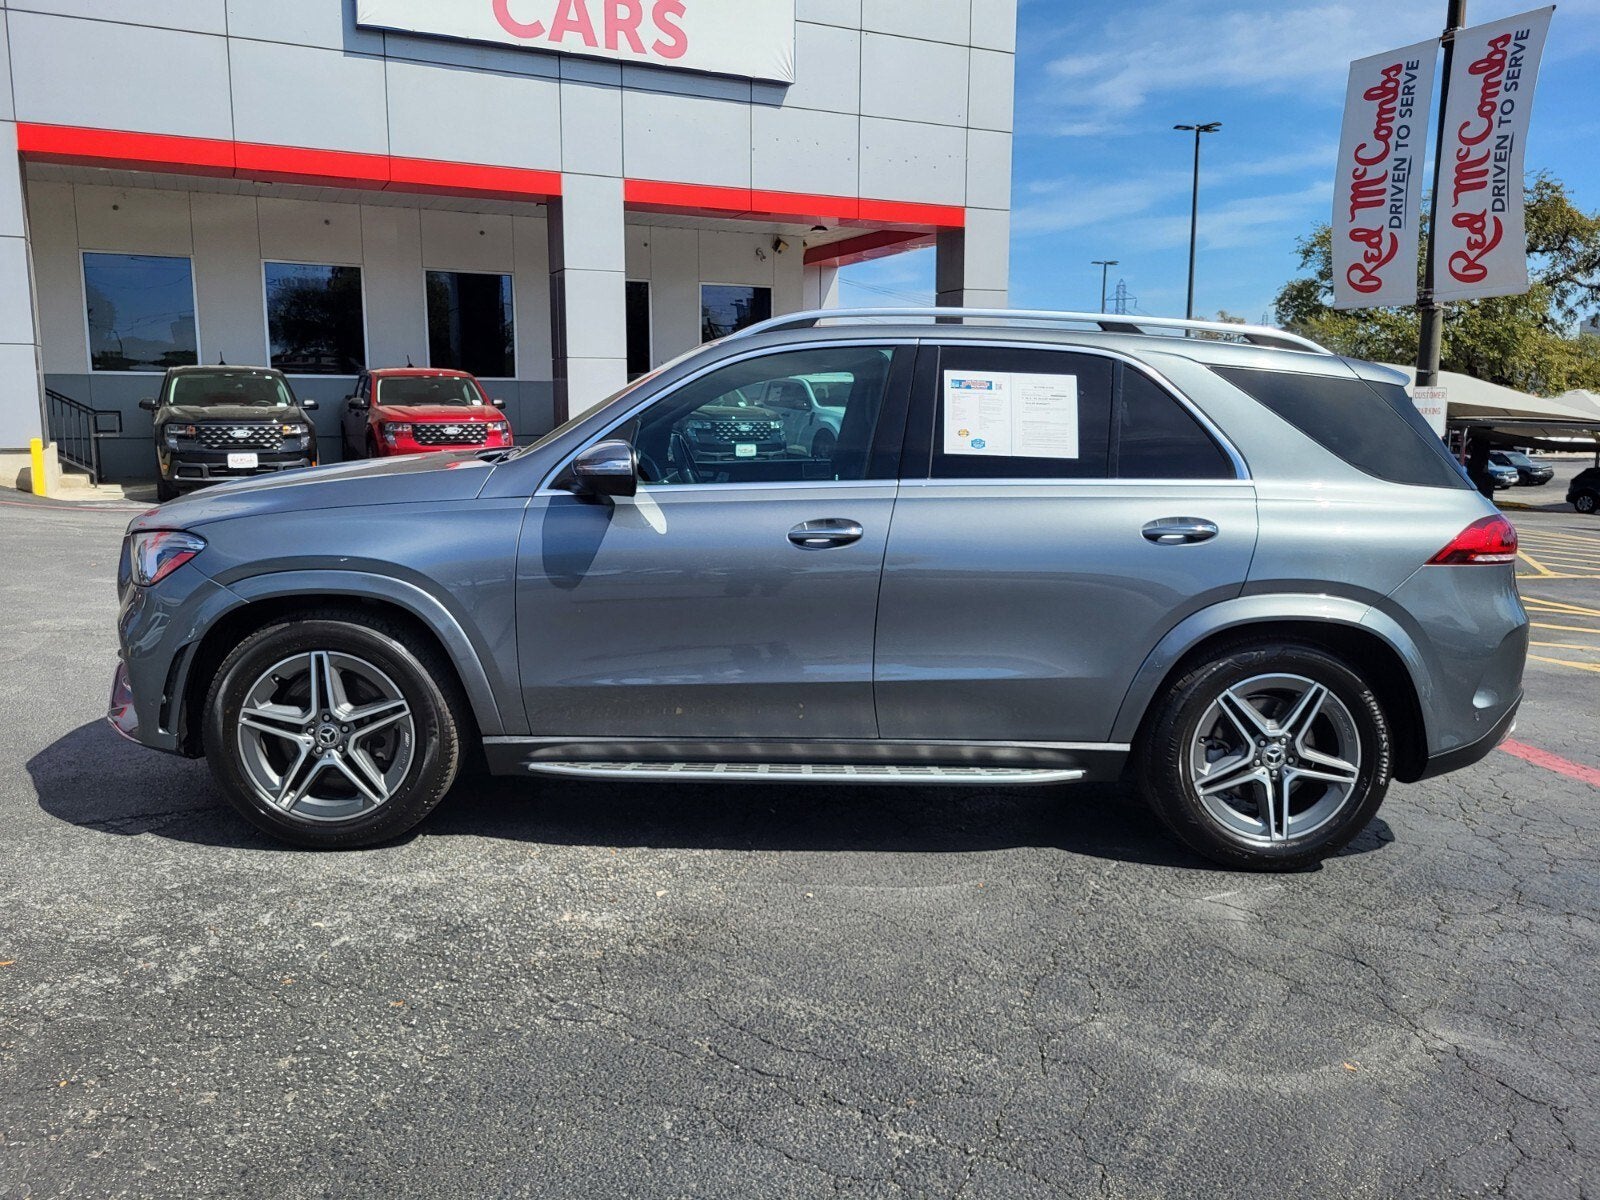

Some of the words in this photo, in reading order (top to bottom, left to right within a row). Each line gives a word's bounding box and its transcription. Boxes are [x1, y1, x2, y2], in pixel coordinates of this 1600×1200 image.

[492, 0, 688, 60] CARS
[1504, 28, 1530, 92] SERVE
[1399, 59, 1420, 118] SERVE
[1452, 33, 1512, 208] McCombs
[1498, 98, 1515, 128] TO
[1349, 63, 1403, 223] McCombs
[1394, 124, 1411, 152] TO
[1388, 157, 1407, 229] DRIVEN
[1491, 134, 1510, 213] DRIVEN
[1346, 224, 1399, 294] Red
[1448, 208, 1503, 284] Red
[1414, 391, 1446, 399] CUSTOMER
